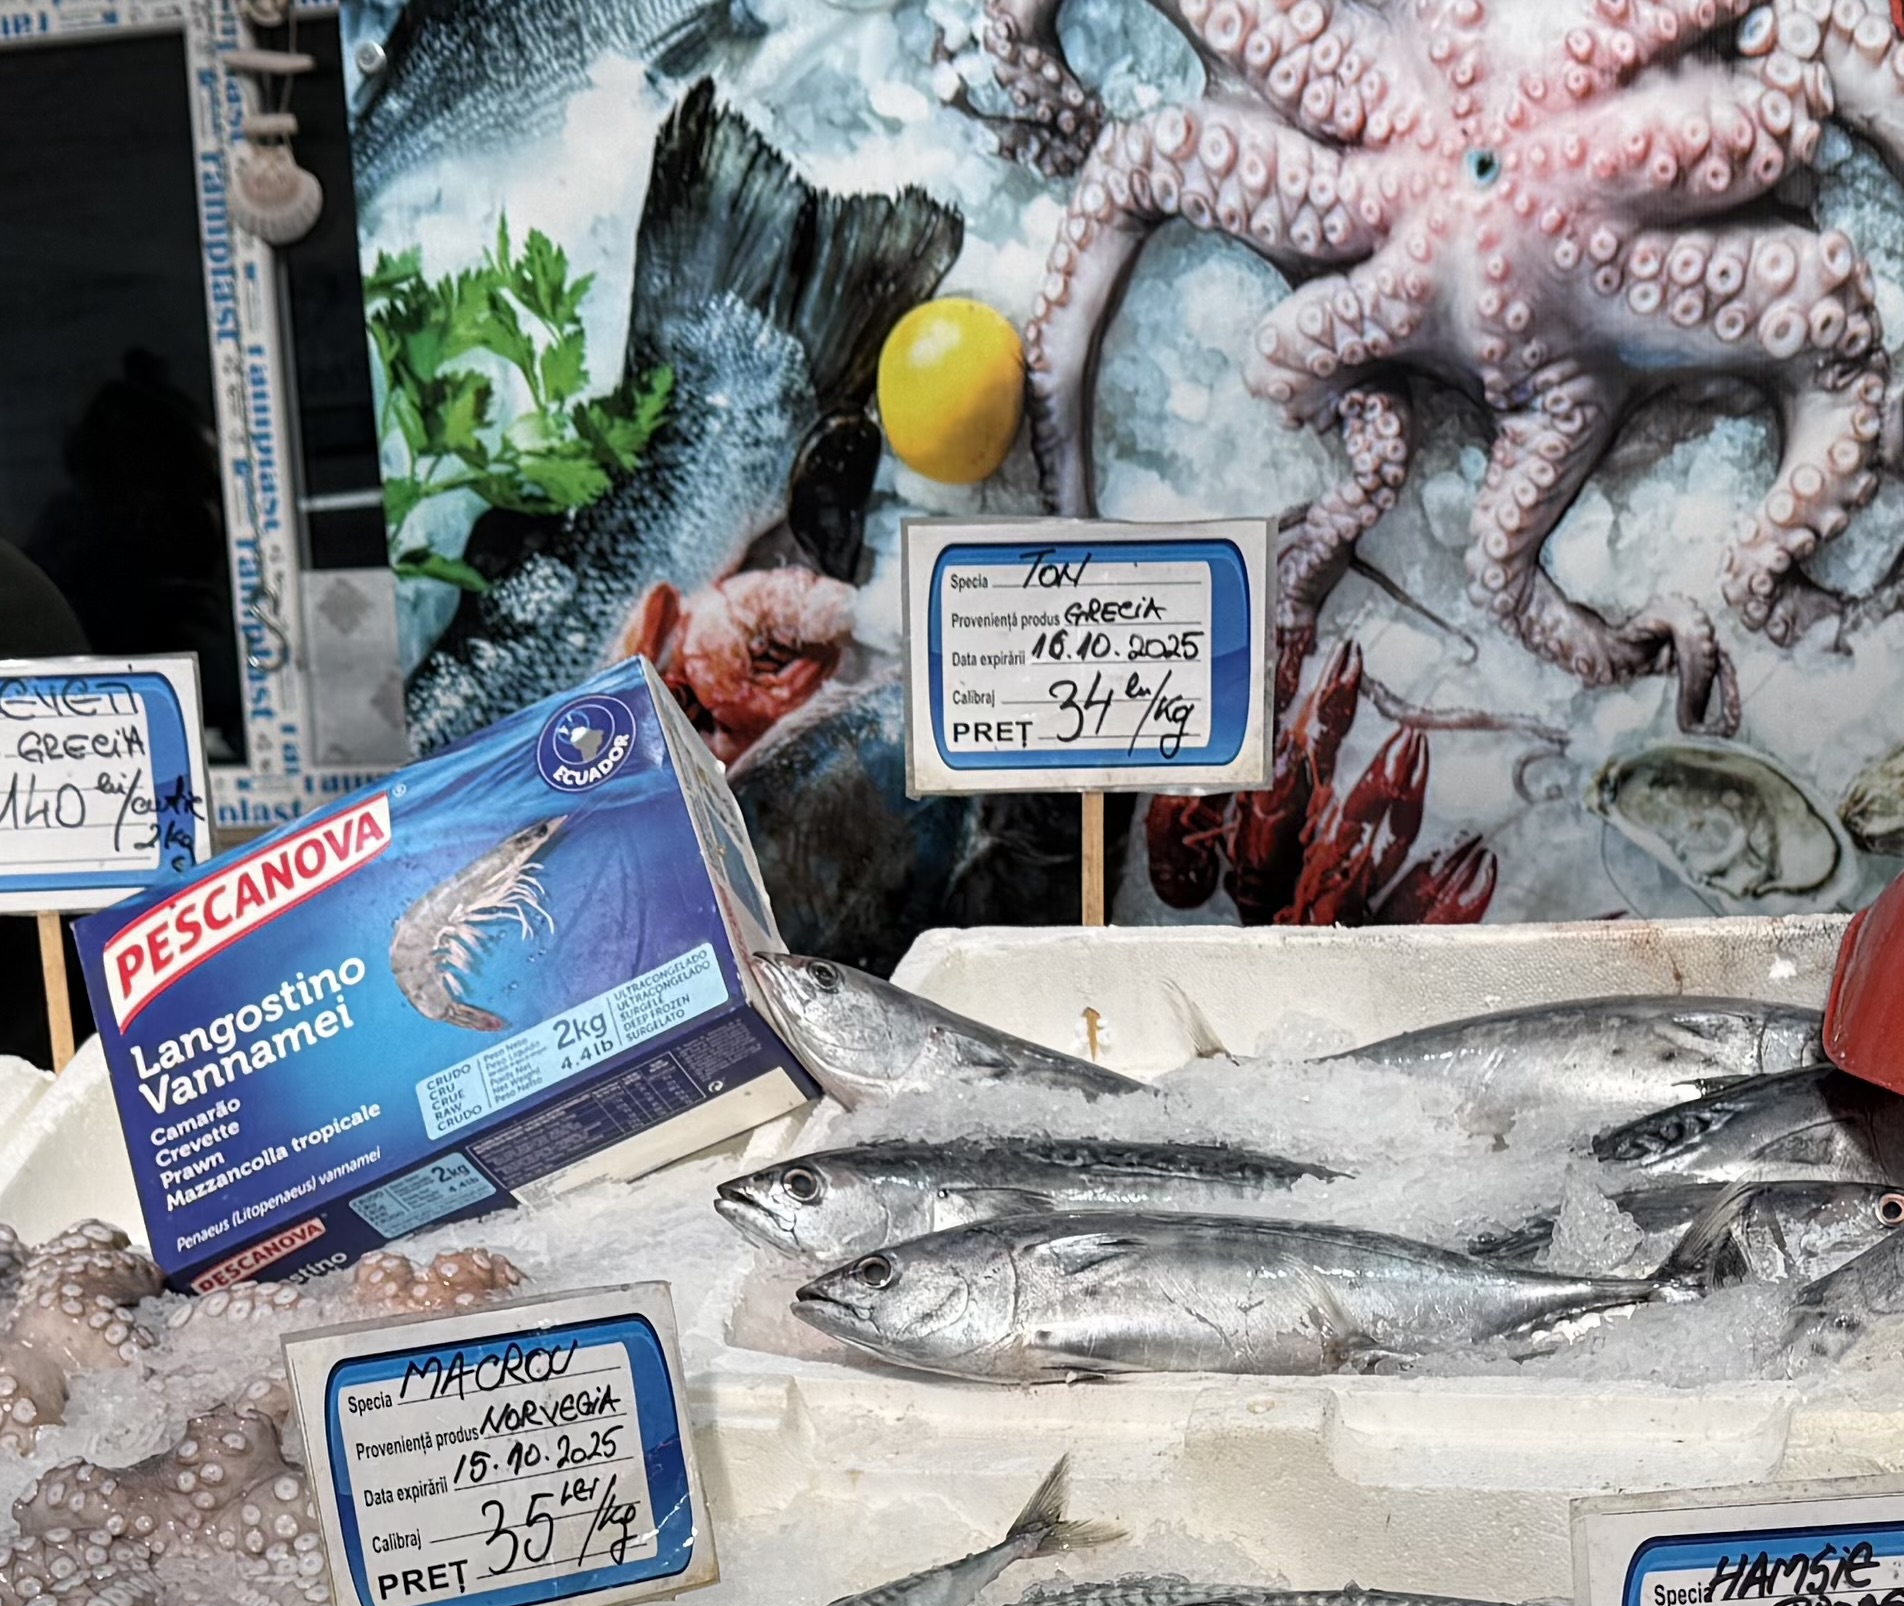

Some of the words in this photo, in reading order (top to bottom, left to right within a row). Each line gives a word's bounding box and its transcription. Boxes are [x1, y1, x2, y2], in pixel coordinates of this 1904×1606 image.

[951, 575, 988, 591] Specia
[1019, 548, 1092, 589] TON
[952, 613, 1020, 631] Proveniență
[1021, 613, 1059, 629] produs
[952, 652, 977, 667] Data
[980, 652, 1025, 667] expirării
[953, 691, 995, 708] Calibraj
[953, 721, 1033, 748] PREȚ
[1049, 671, 1113, 742] 34
[553, 734, 629, 786] ECUADOR
[116, 811, 385, 1000] PESCANOVA
[613, 949, 708, 1001] ULTRACONGELADO
[617, 960, 711, 1012] ULTRACONGELADO
[131, 957, 366, 1080] Langostino
[553, 1010, 607, 1050] 2kg
[623, 1013, 649, 1032] DEEP
[649, 995, 691, 1022] FROZEN
[625, 1008, 685, 1042] SURGELATO
[138, 995, 354, 1115] Vannamei
[427, 1064, 471, 1091] CRUDO
[429, 1084, 456, 1101] CRU
[432, 1089, 465, 1111] CRUE
[435, 1103, 463, 1121] RAW
[437, 1104, 482, 1132] CRUDO
[150, 1098, 241, 1146] Camarão
[155, 1121, 240, 1167] Crevette
[166, 1146, 289, 1211] Mazzancolla
[291, 1103, 381, 1152] tropicale
[160, 1151, 225, 1189] Prawn
[177, 1220, 230, 1252] Penaeus
[319, 1145, 381, 1186] vannamei
[348, 1392, 393, 1414] Specia
[356, 1433, 434, 1461] Proveniență
[435, 1425, 479, 1449] produs
[364, 1487, 394, 1508] Data
[396, 1476, 449, 1502] expirării
[372, 1529, 423, 1554] Calibraj
[378, 1559, 468, 1600] PREȚ
[481, 1491, 555, 1576] 35
